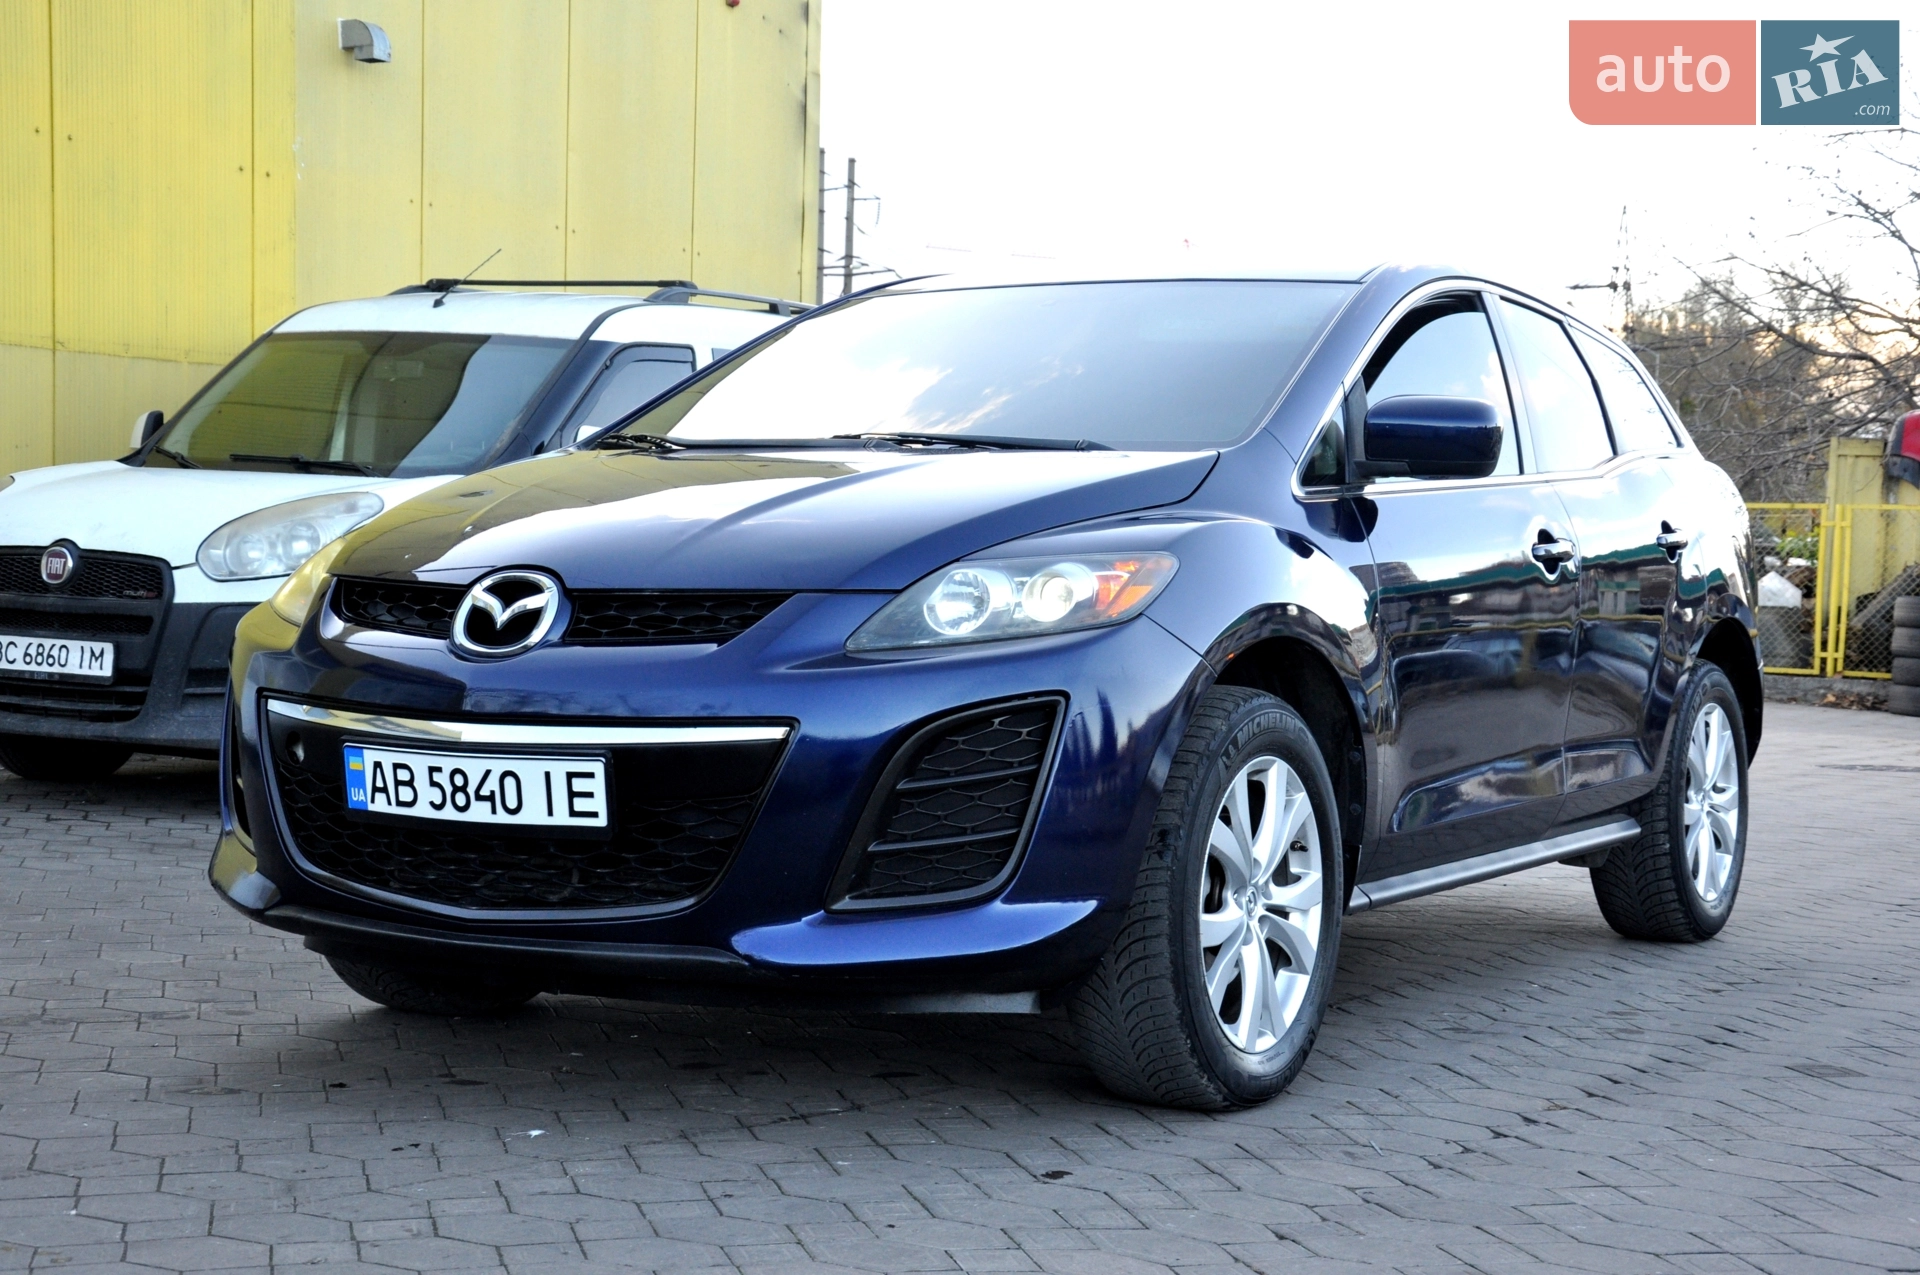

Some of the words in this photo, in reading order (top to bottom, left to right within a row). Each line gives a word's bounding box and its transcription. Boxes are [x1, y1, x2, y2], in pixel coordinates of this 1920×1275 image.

[47, 557, 66, 575] FIAT
[23, 642, 70, 668] 6860
[79, 645, 105, 671] IM
[1237, 712, 1297, 748] MICHELIN
[350, 787, 366, 803] UA
[370, 760, 419, 808] AB
[428, 765, 524, 816] 5840
[544, 770, 600, 819] IE
